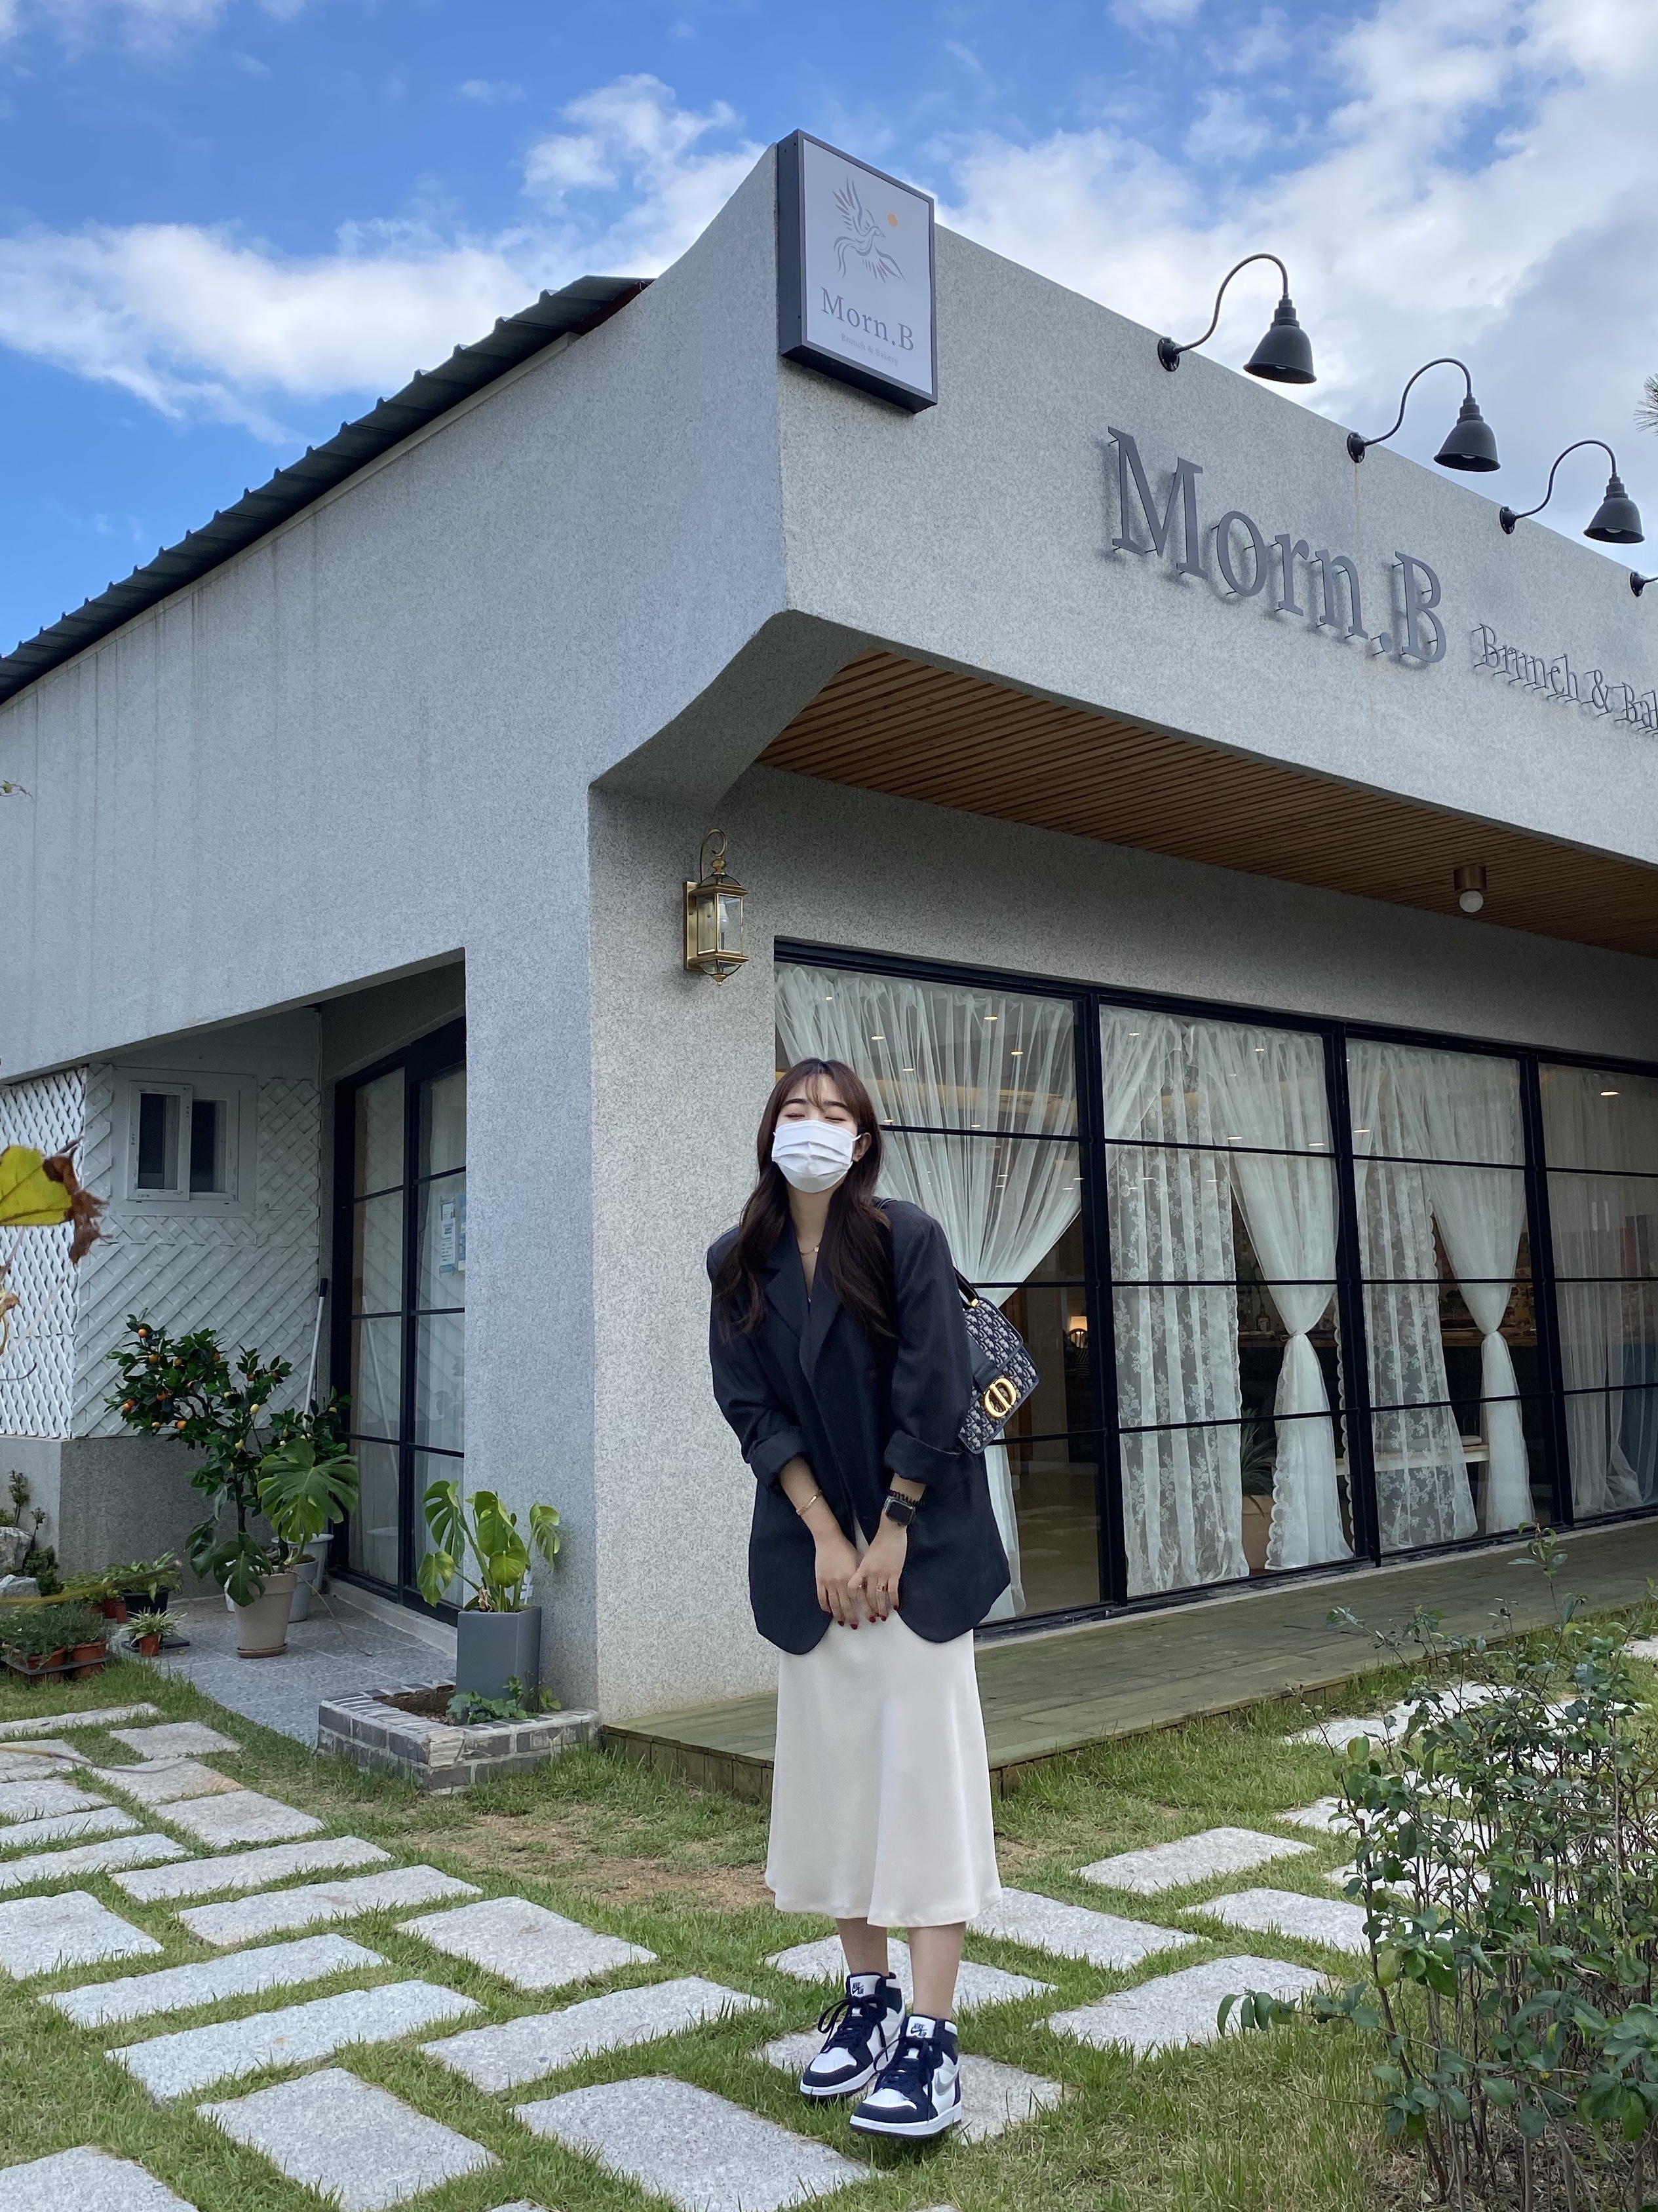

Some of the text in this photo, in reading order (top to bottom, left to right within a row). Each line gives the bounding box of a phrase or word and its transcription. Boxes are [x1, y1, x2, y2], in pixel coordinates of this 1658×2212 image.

[821, 286, 914, 351] Morn.B
[841, 332, 898, 367] Brunch & Bakery
[1108, 426, 1447, 662] Morn.B
[1478, 622, 1581, 702] Brunch
[1592, 669, 1613, 714] &
